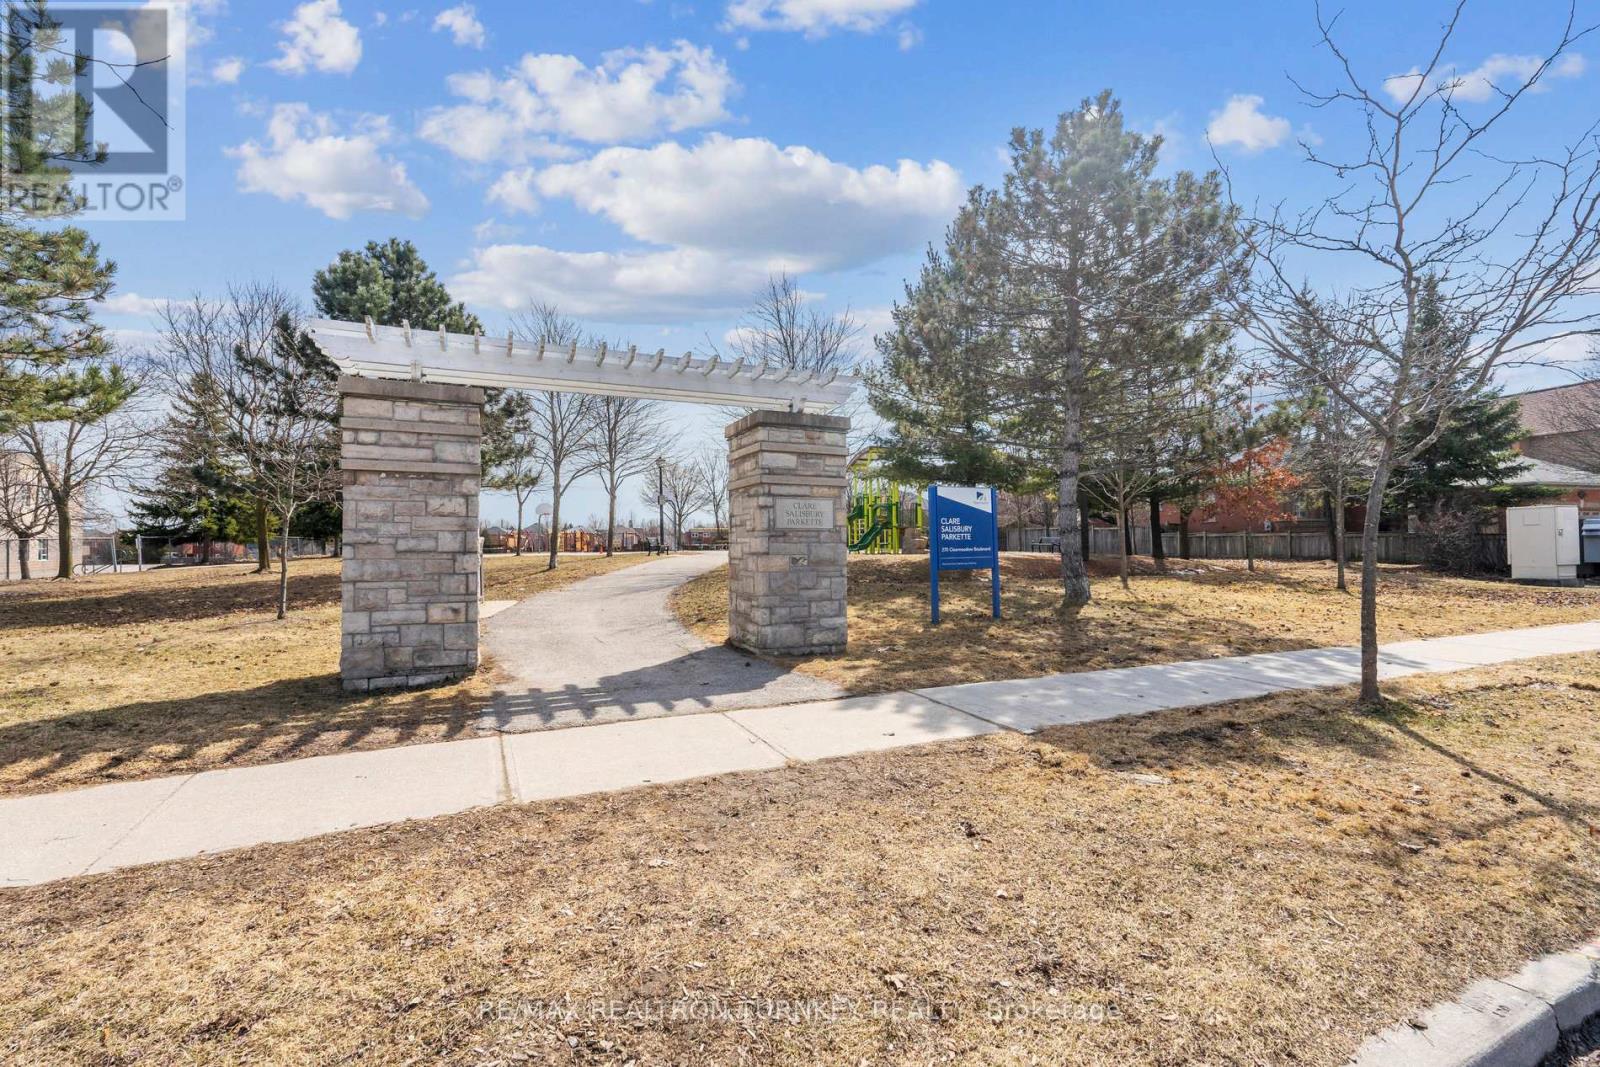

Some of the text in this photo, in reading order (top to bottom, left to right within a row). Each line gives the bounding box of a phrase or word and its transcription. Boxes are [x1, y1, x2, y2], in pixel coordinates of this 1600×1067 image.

[792, 502, 817, 510] CLARE
[784, 510, 824, 518] SALISBURY
[785, 518, 824, 526] PARKETTE
[940, 517, 961, 525] CLARE
[940, 525, 973, 533] SALISBURY
[941, 533, 972, 541] PARKETTE
